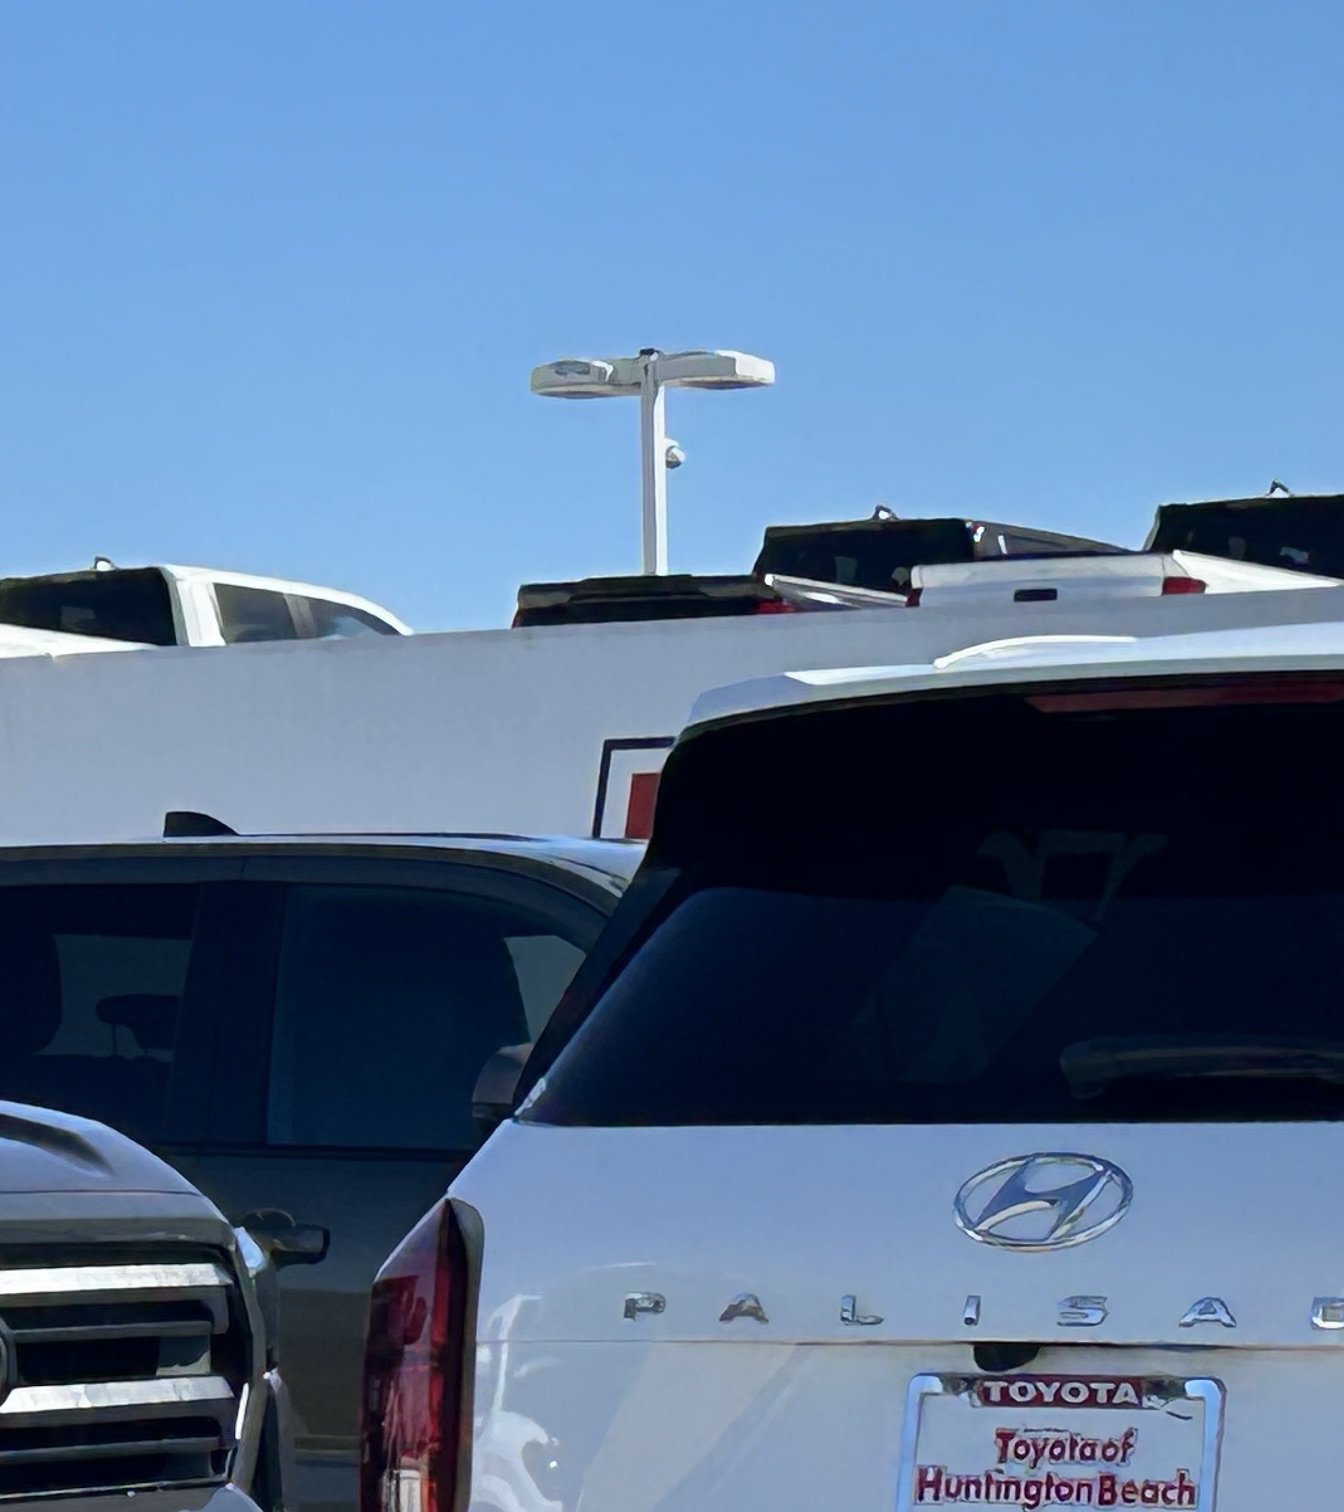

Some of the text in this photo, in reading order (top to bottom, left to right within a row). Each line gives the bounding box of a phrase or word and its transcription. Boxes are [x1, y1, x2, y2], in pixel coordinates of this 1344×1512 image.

[984, 1381, 1140, 1405] TOYOTA
[995, 1427, 1138, 1469] Toyota of
[914, 1465, 1198, 1512] Huntington Beach
